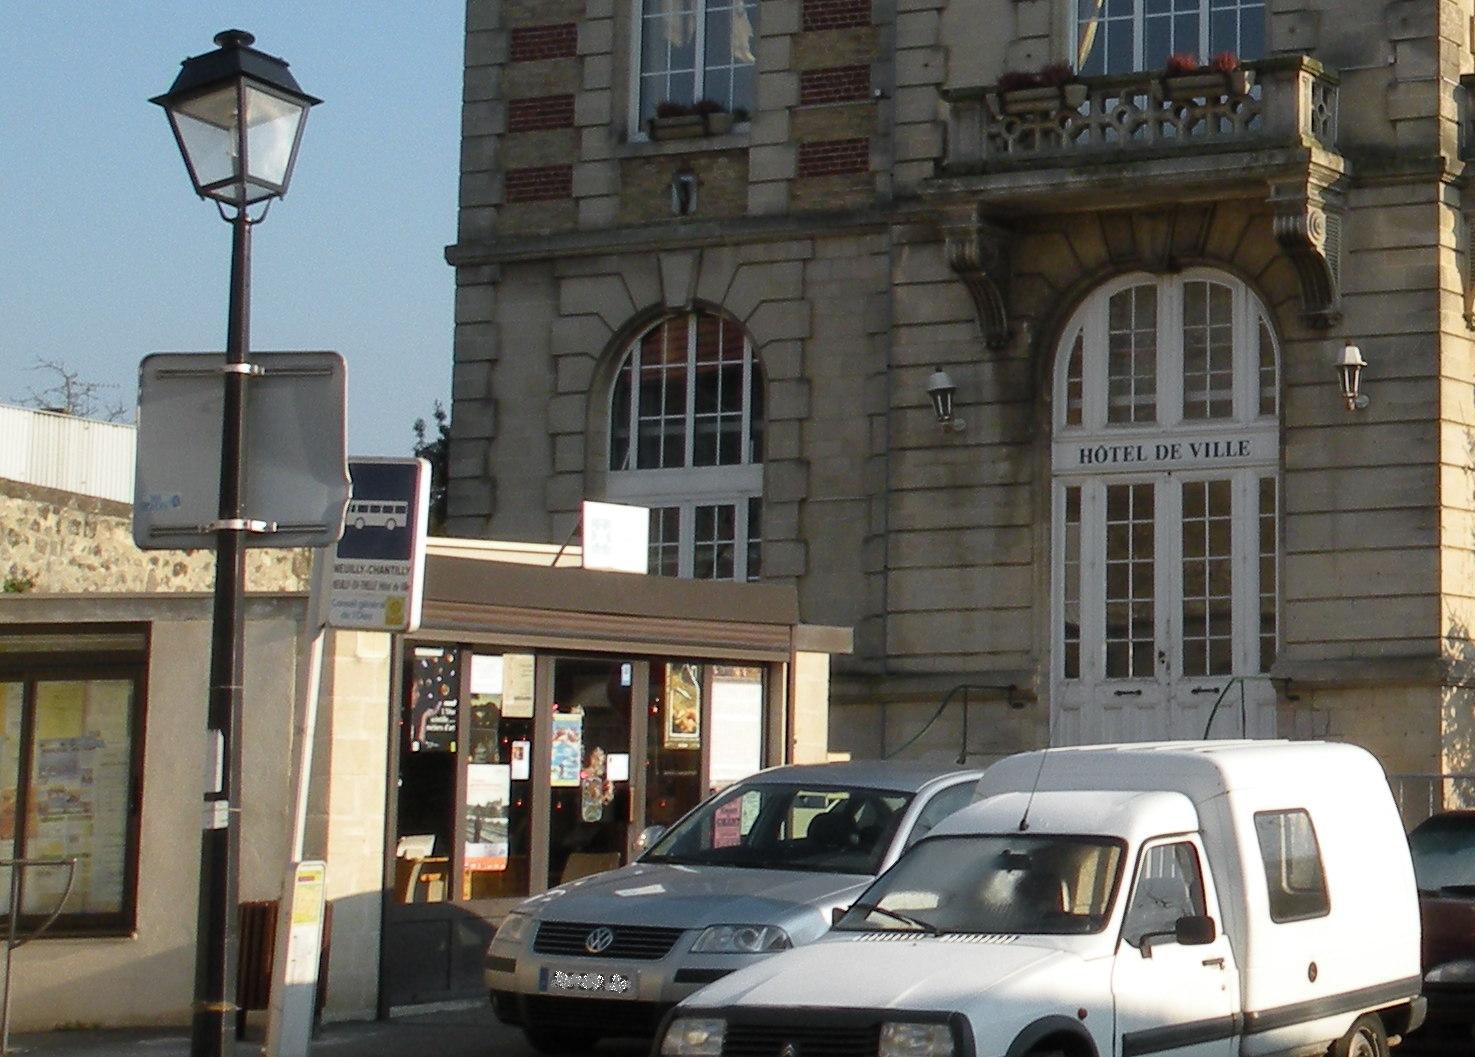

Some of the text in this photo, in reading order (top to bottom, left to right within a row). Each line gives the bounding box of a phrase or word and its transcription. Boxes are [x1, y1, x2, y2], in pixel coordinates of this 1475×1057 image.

[1079, 440, 1251, 465] HÔTEL DE VILLE
